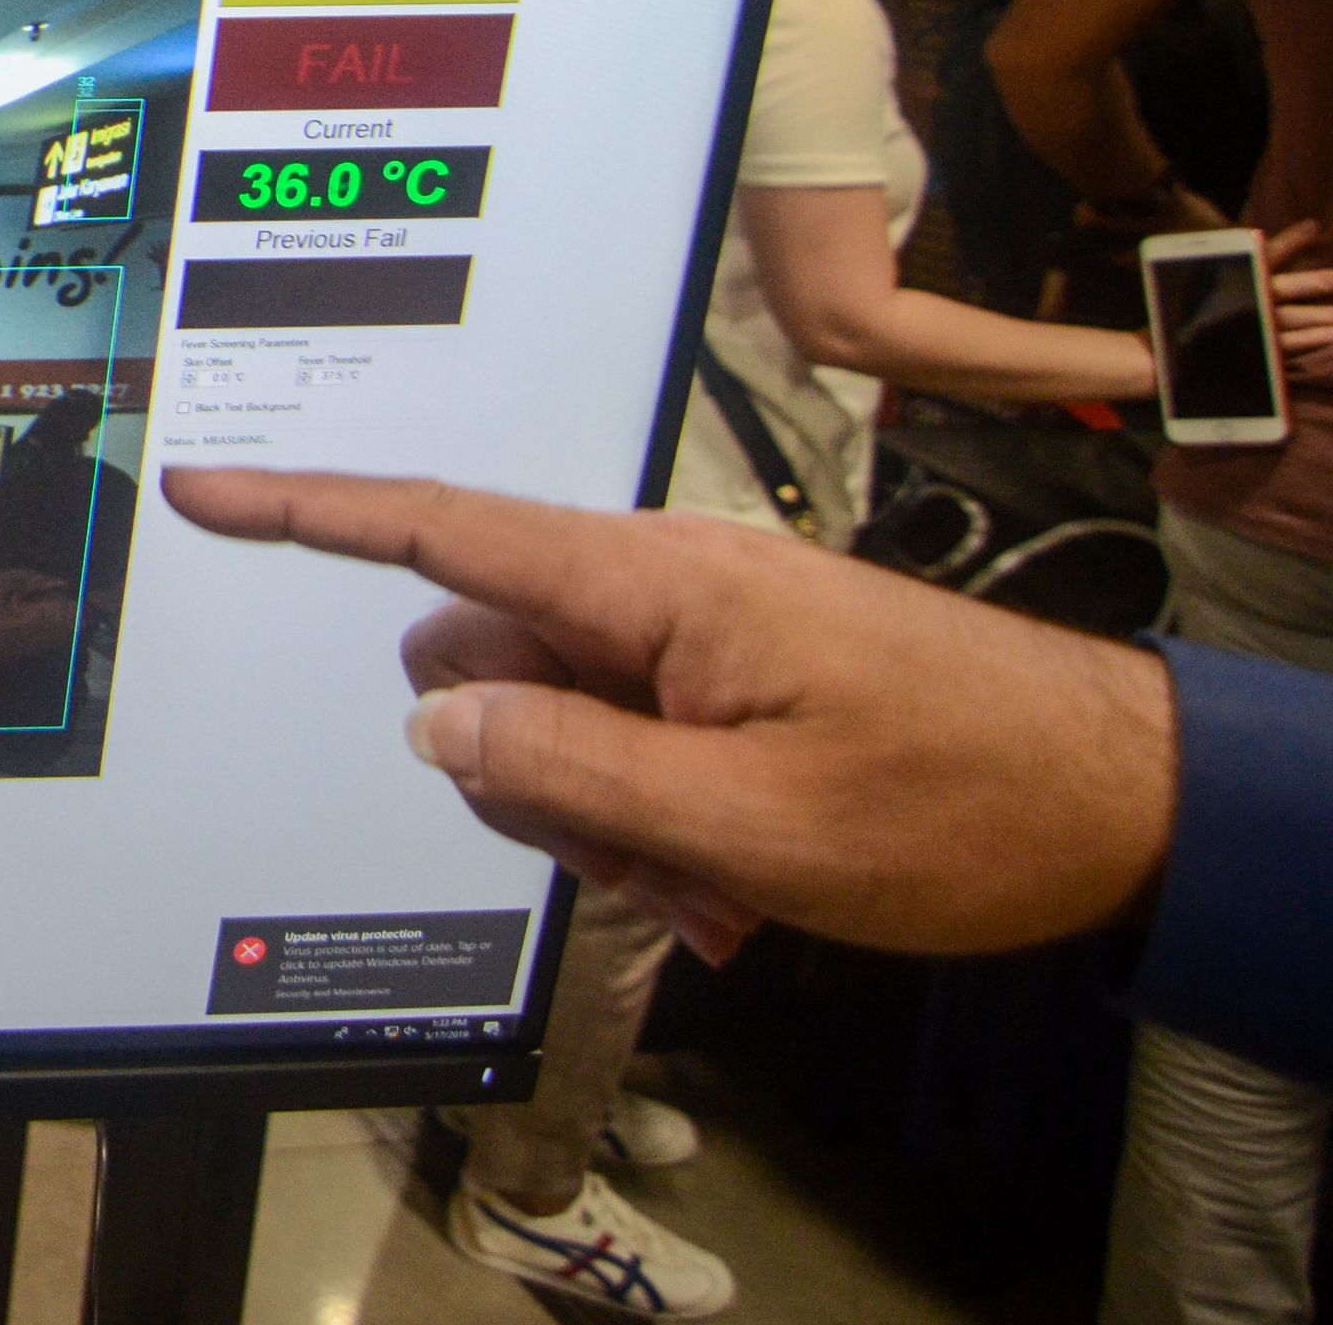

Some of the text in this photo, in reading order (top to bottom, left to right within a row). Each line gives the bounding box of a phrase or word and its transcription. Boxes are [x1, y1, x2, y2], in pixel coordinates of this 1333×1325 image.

[296, 43, 414, 85] FAIL
[303, 119, 395, 140] Current
[238, 159, 450, 209] 36.0 °C
[255, 227, 408, 251] Previous Fail
[181, 337, 309, 350] Fever Screening Parameters
[183, 357, 234, 368] Skin Offset
[298, 355, 373, 366] Fever Threshold
[19, 384, 64, 400] 923
[194, 402, 302, 413] Black Text Background
[163, 436, 197, 447] Status:
[285, 927, 423, 944] Update virus protection
[284, 943, 312, 956] Virus
[314, 941, 374, 957] protection
[376, 942, 386, 953] is
[388, 942, 408, 953] out
[411, 941, 423, 952] of
[458, 940, 477, 954] Tap
[479, 941, 492, 950] or
[280, 954, 475, 971] click to update Windows Defender
[278, 972, 331, 985] Antivirus.
[275, 986, 391, 1000] Security and Maintenance
[432, 1017, 468, 1027] 1:33 PM
[424, 1029, 469, 1041] 5/17/2019
